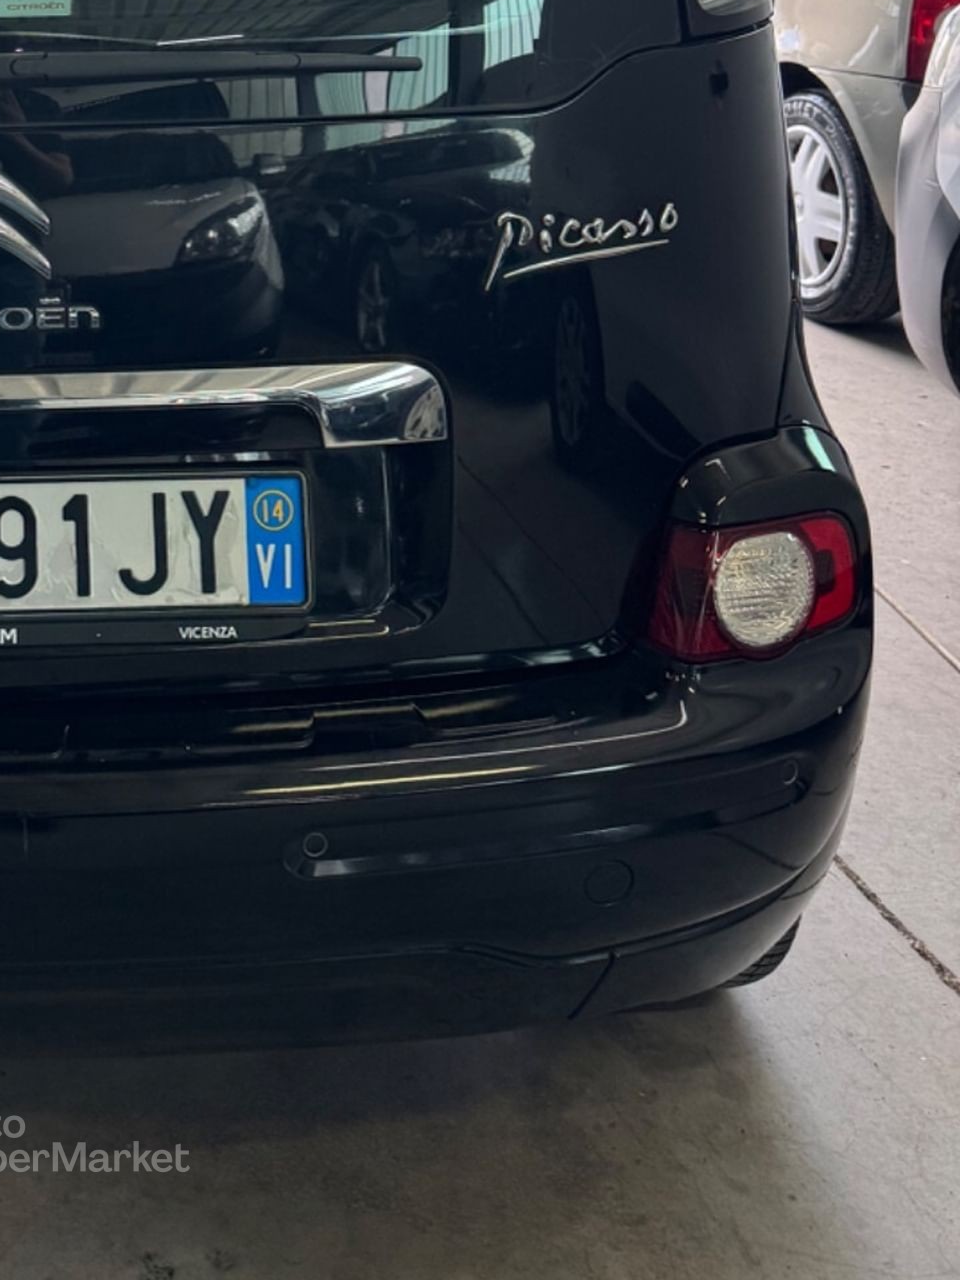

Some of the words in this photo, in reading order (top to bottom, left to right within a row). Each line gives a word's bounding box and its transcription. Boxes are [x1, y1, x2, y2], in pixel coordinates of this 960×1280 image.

[484, 202, 679, 292] Picasso
[262, 498, 284, 523] 14
[255, 543, 292, 589] VI
[178, 625, 239, 640] VICENZA
